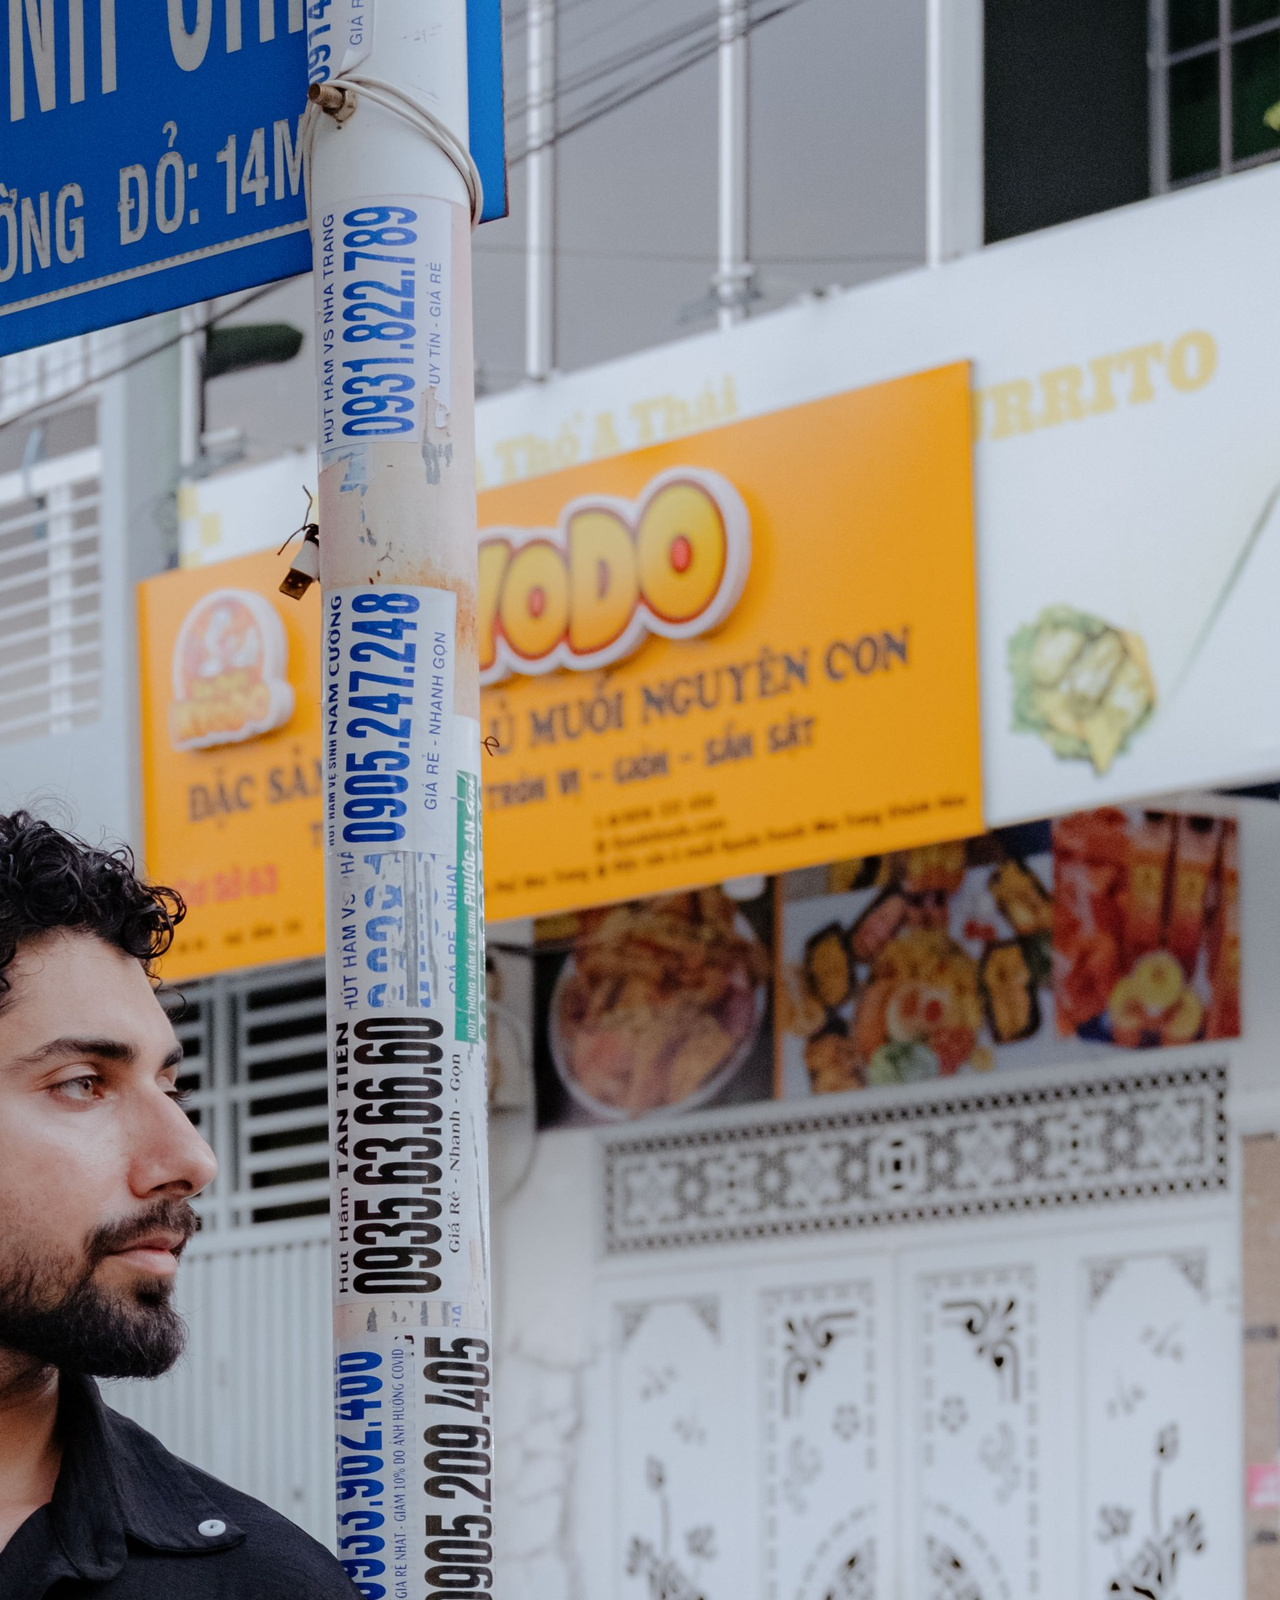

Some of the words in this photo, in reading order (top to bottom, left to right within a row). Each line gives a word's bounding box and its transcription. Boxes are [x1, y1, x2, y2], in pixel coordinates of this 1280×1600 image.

[118, 120, 200, 245] ĐỎ:
[322, 214, 334, 280] TRANG
[425, 262, 441, 284] RẺ
[322, 283, 334, 323] NHA
[341, 206, 418, 437] 0931.822.789
[425, 290, 441, 318] GIÁ
[322, 329, 334, 354] VS
[426, 332, 441, 358] TÍN
[973, 330, 1217, 446] RRITO
[327, 595, 342, 677] CƯỜNG
[432, 631, 447, 669] GỌN
[824, 624, 911, 682] CON
[328, 683, 338, 736] NAM
[342, 592, 420, 844] 0905.247.248
[429, 675, 444, 735] NHANH
[328, 740, 337, 770] SINH
[421, 752, 439, 775] RẺ
[422, 781, 438, 810] GIÁ
[463, 820, 476, 846] AN
[460, 849, 477, 907] PHƯỚC
[449, 1054, 464, 1092] Gọn
[334, 1107, 349, 1181] TÂN
[352, 1017, 444, 1295] 0935.63.66.60
[448, 1110, 461, 1172] Nhanh
[446, 1190, 461, 1216] Rẻ
[447, 1222, 461, 1254] Giá
[337, 1251, 349, 1294] Hút
[391, 1349, 404, 1380] COVID
[393, 1450, 406, 1465] DO
[393, 1468, 406, 1491] 10%
[391, 1581, 407, 1599] GIÁ
